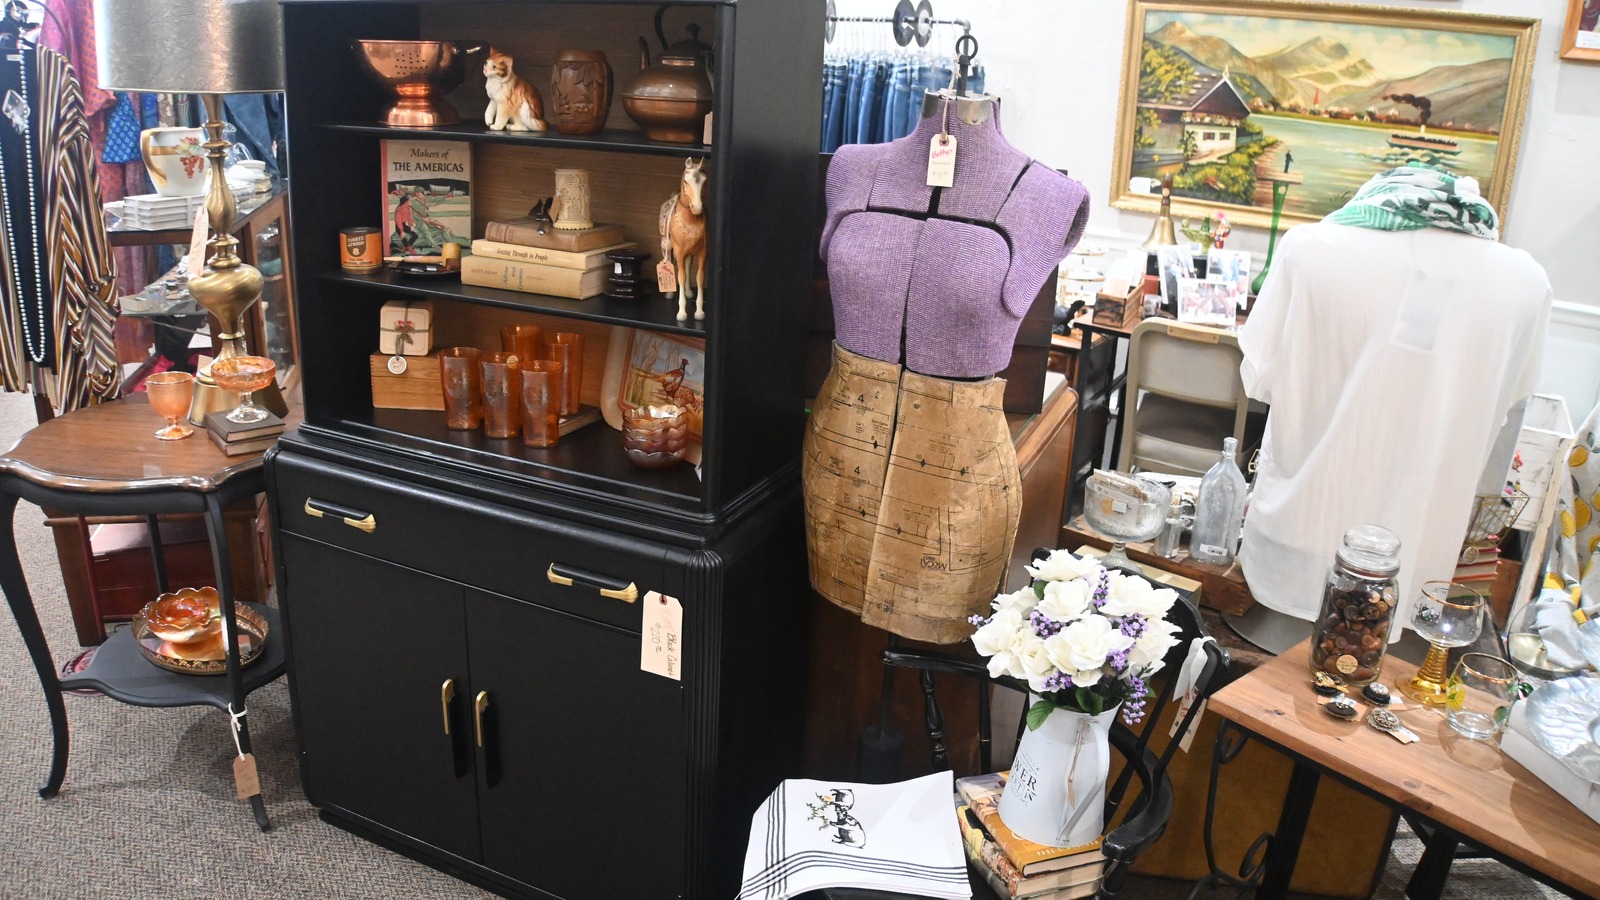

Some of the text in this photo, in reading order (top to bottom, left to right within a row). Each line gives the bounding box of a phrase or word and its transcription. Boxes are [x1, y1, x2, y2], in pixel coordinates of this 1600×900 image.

[409, 148, 451, 160] Makers of
[393, 162, 464, 172] THE AMERICAS
[496, 248, 511, 257] Getting
[512, 250, 528, 259] Through
[535, 253, 549, 261] People
[858, 394, 864, 403] 4
[854, 466, 860, 475] 4
[666, 632, 678, 653] Black
